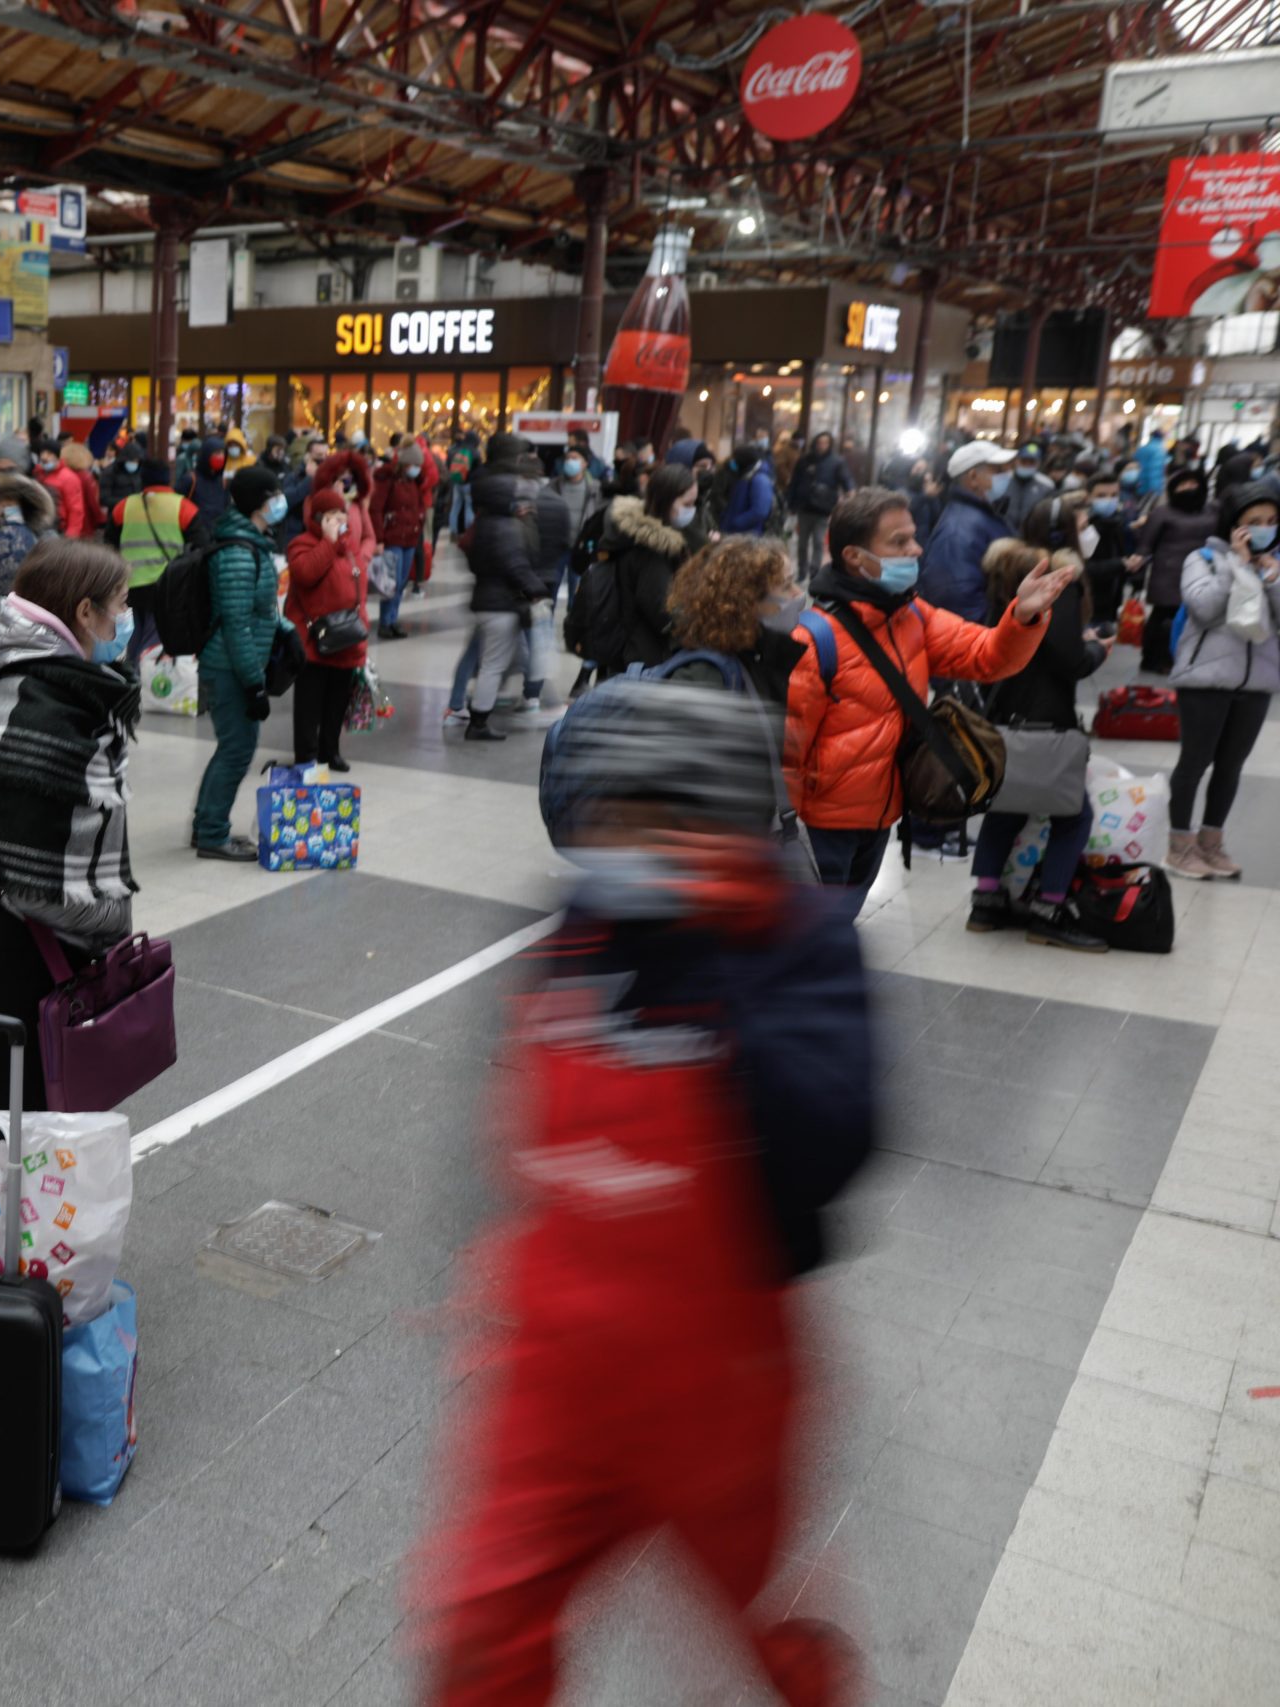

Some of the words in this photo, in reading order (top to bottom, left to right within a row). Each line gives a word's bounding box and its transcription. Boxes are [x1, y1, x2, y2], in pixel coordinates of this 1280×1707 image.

[744, 48, 856, 103] Coca-Cola
[336, 313, 383, 354] SO!
[390, 309, 495, 354] COFFEE
